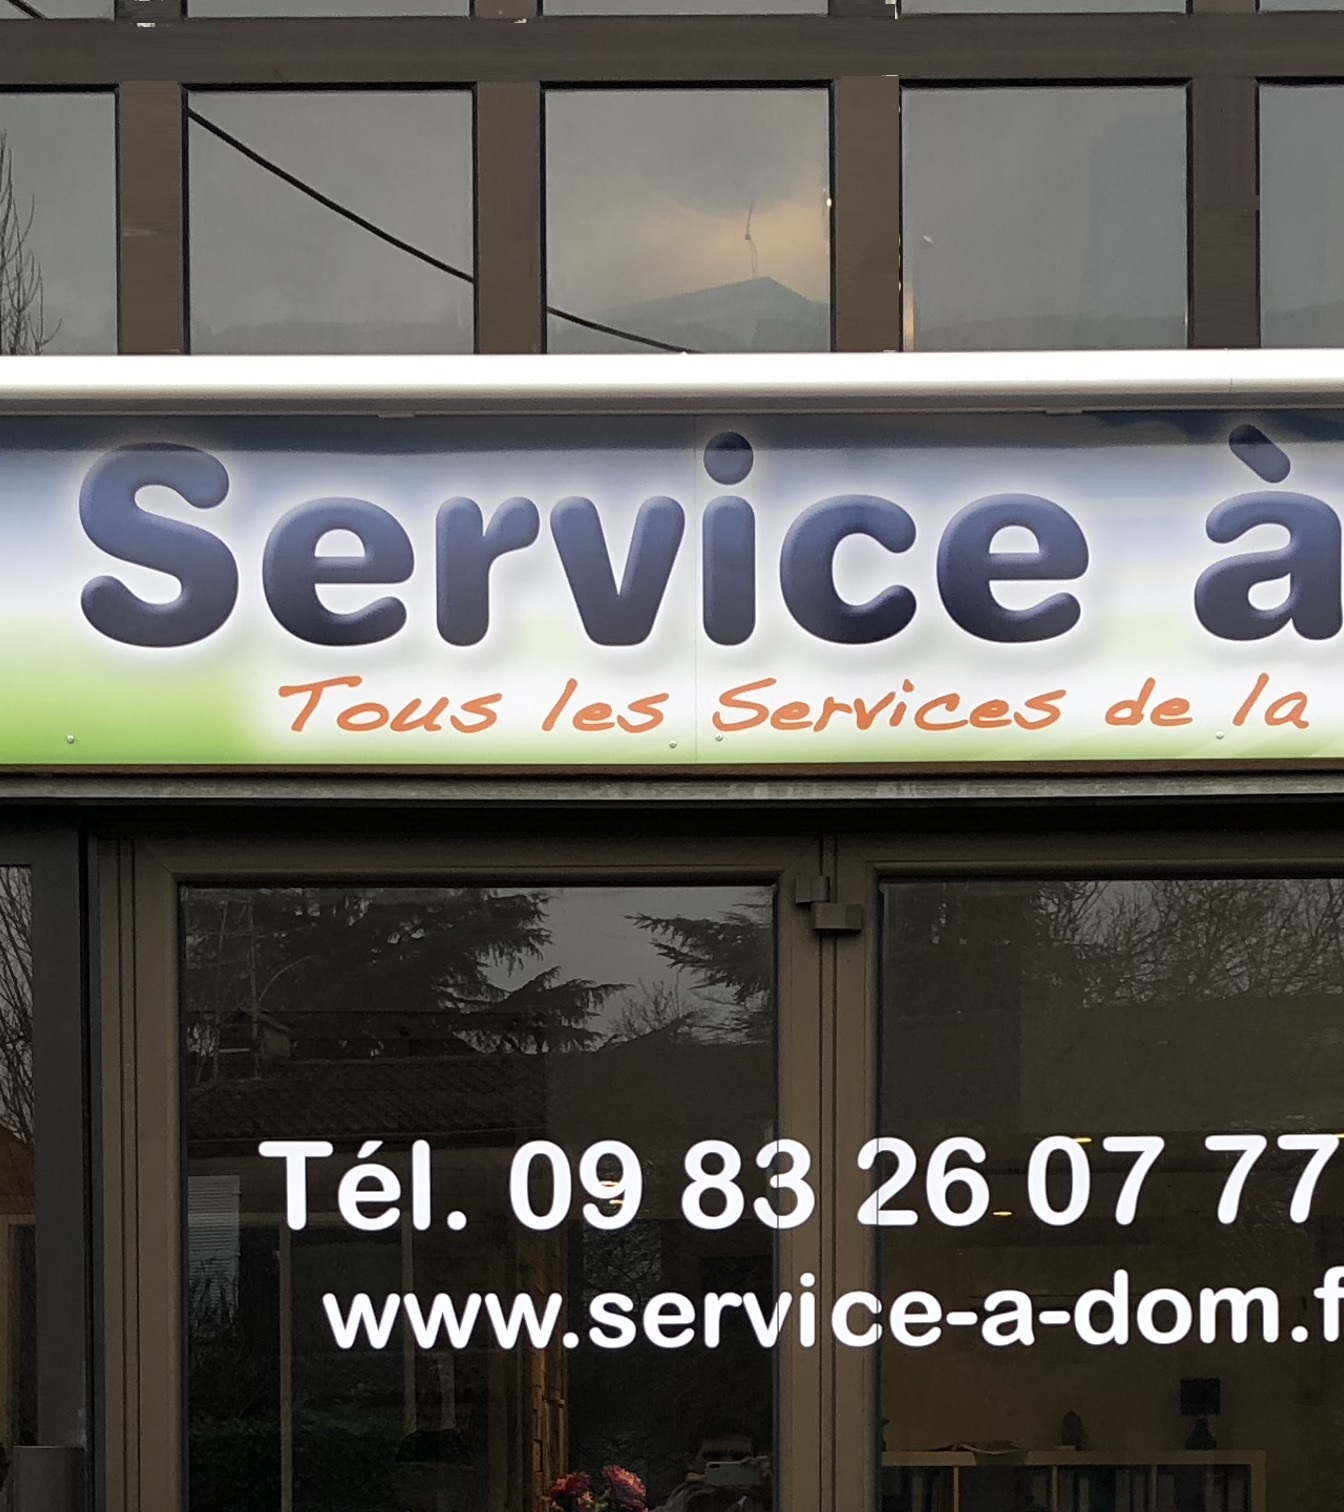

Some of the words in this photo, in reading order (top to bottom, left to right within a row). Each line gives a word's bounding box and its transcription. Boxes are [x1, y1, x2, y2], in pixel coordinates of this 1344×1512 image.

[78, 430, 1089, 648] Service
[1194, 424, 1344, 640] à
[277, 675, 504, 735] Tous
[540, 679, 669, 734] les
[712, 677, 1066, 733] Services
[1103, 676, 1194, 728] de
[1231, 673, 1309, 730] la
[258, 1139, 467, 1231] Tél.
[509, 1139, 643, 1231] 09
[681, 1138, 816, 1230] 83
[857, 1136, 990, 1227] 26
[1027, 1135, 1165, 1226] 07
[1204, 1134, 1340, 1225] 77
